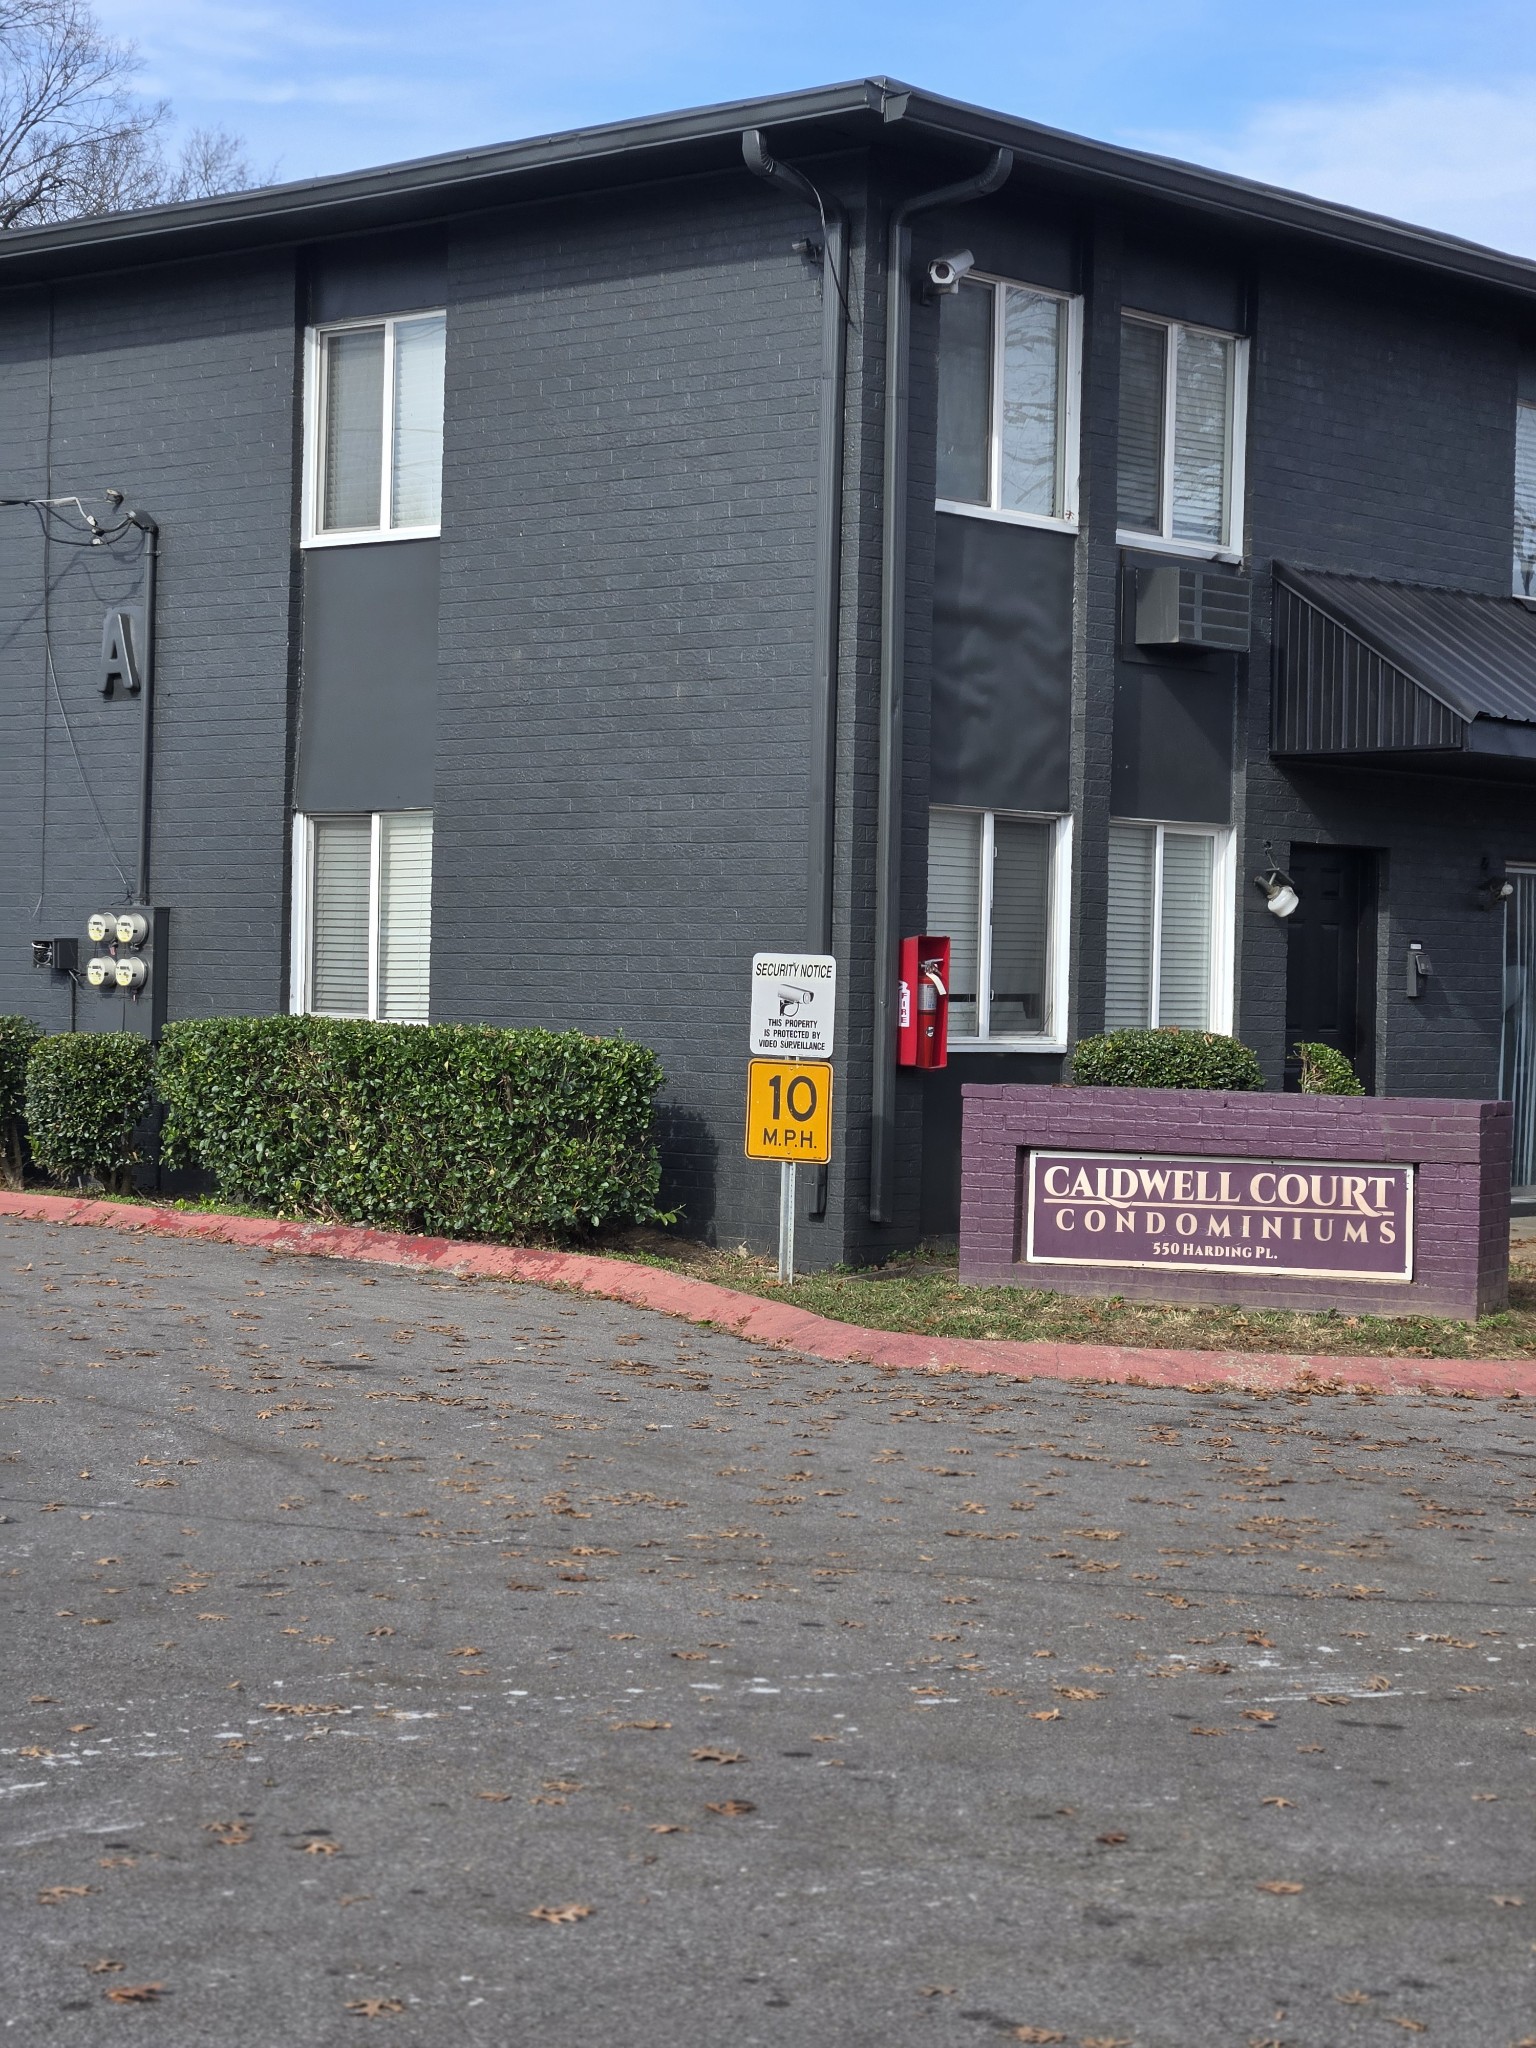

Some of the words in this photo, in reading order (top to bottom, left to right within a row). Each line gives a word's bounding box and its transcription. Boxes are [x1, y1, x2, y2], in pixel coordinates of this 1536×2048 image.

[97, 609, 140, 697] A
[755, 963, 799, 977] SECURITY
[800, 964, 832, 978] NOTICE
[768, 1018, 782, 1027] THIS
[785, 1019, 817, 1028] PROPERTY
[764, 1028, 771, 1037] IS
[773, 1029, 809, 1039] PROTECTED
[812, 1031, 821, 1039] BY
[758, 1038, 778, 1048] VIDEO
[780, 1040, 825, 1050] SURVEILLANCE
[768, 1074, 817, 1122] 10
[763, 1128, 817, 1149] M.P.H.
[1044, 1165, 1241, 1209] CALDWELL
[1250, 1172, 1395, 1218] COURT
[1055, 1208, 1396, 1244] CONDOMINIUMS
[1152, 1242, 1180, 1256] 550
[1182, 1243, 1252, 1258] HARDING
[1255, 1246, 1278, 1260] PL.
